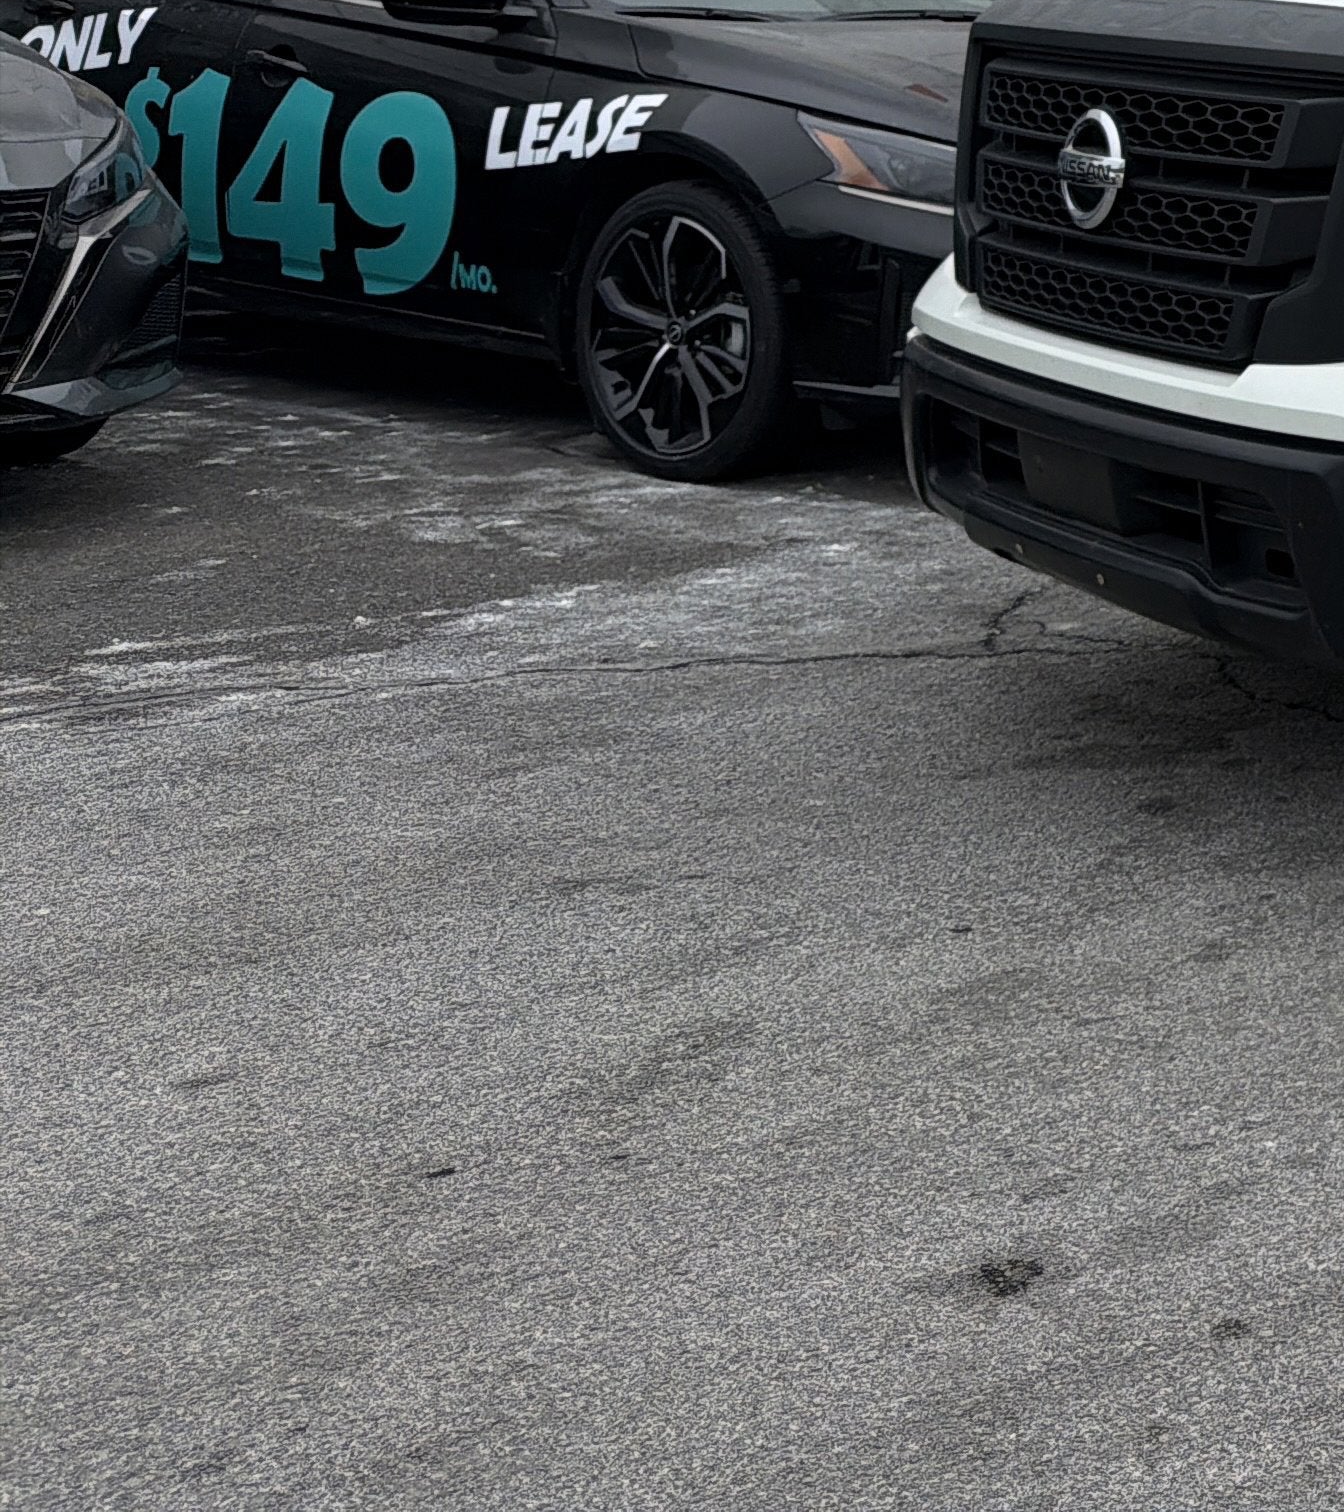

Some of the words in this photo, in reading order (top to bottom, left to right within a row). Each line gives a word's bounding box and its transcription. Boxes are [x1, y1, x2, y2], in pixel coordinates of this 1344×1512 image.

[20, 6, 159, 72] ONLY
[484, 93, 669, 171] LEASE
[124, 66, 457, 295] $149
